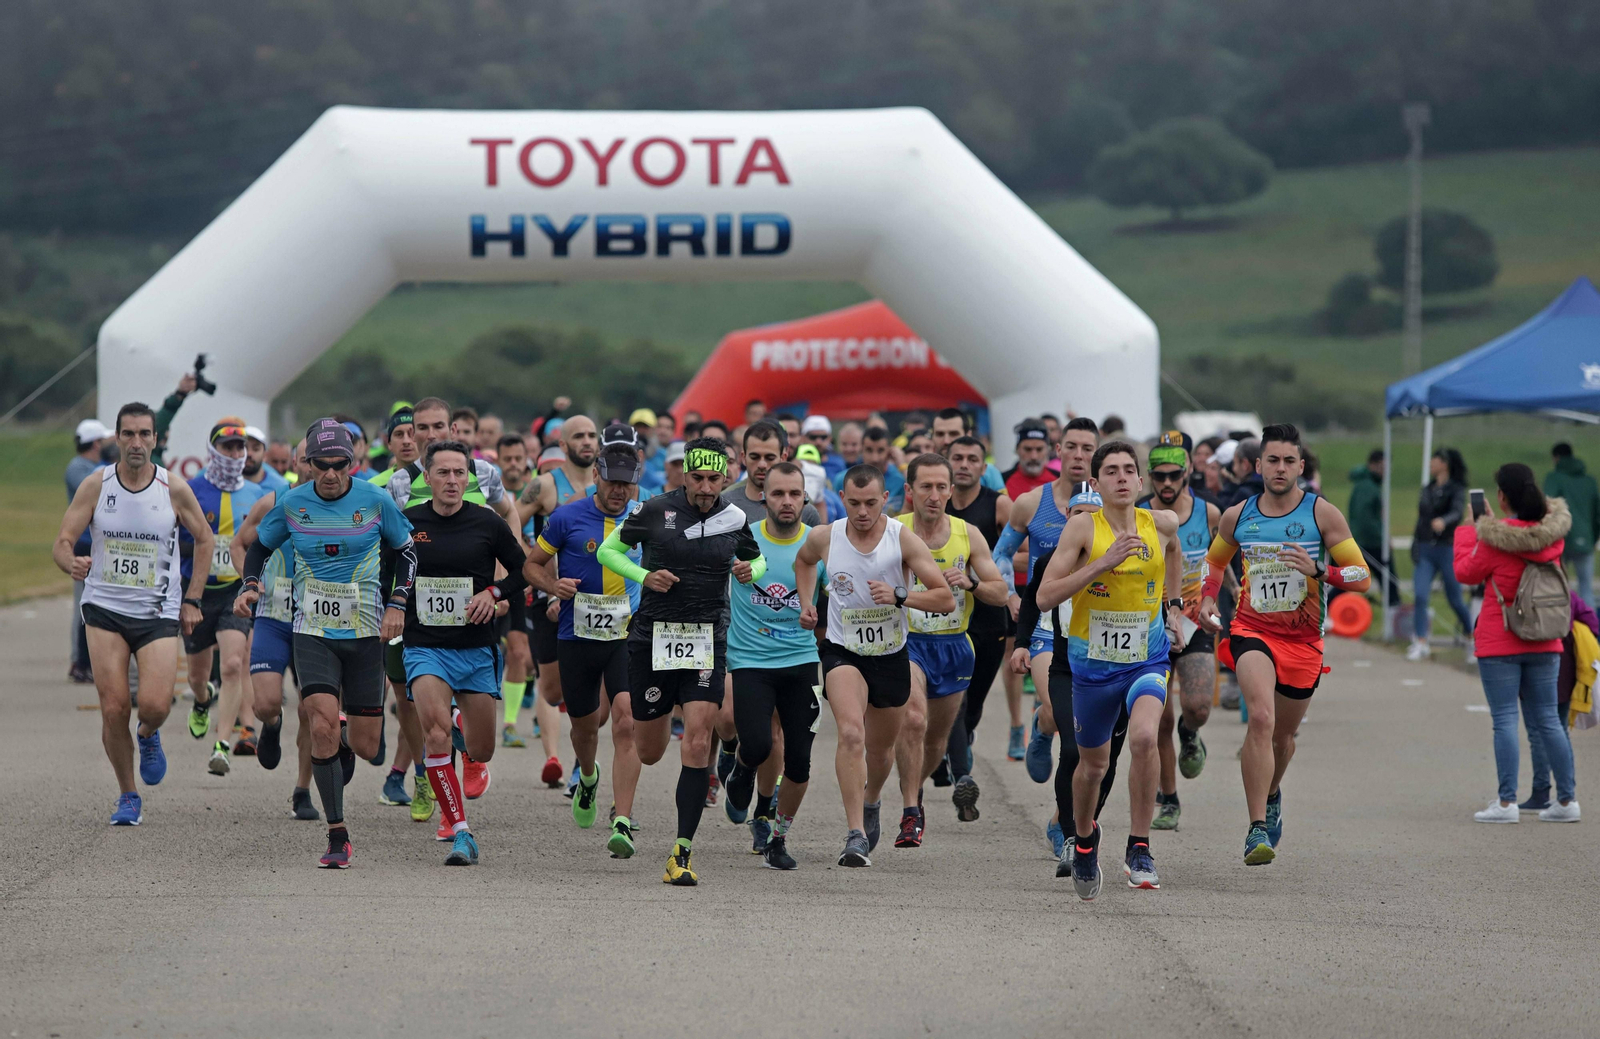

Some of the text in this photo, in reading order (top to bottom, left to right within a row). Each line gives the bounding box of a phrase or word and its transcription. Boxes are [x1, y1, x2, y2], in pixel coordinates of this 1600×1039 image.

[469, 137, 791, 187] TOYOTA
[469, 213, 792, 257] HYBRID
[751, 336, 929, 371] PROTECCION
[690, 450, 721, 471] Buff
[103, 530, 160, 541] POLICIA LOCAL
[113, 558, 139, 575] 158
[321, 586, 356, 594] NAVARRETE
[1087, 589, 1110, 598] Vopak
[1261, 582, 1288, 599] 117
[313, 599, 340, 617] 108
[427, 596, 455, 613] 130
[585, 613, 613, 629] 122
[861, 609, 896, 619] NAVARRETE
[855, 626, 884, 644] 101
[1101, 630, 1131, 650] 112
[665, 642, 694, 659] 162
